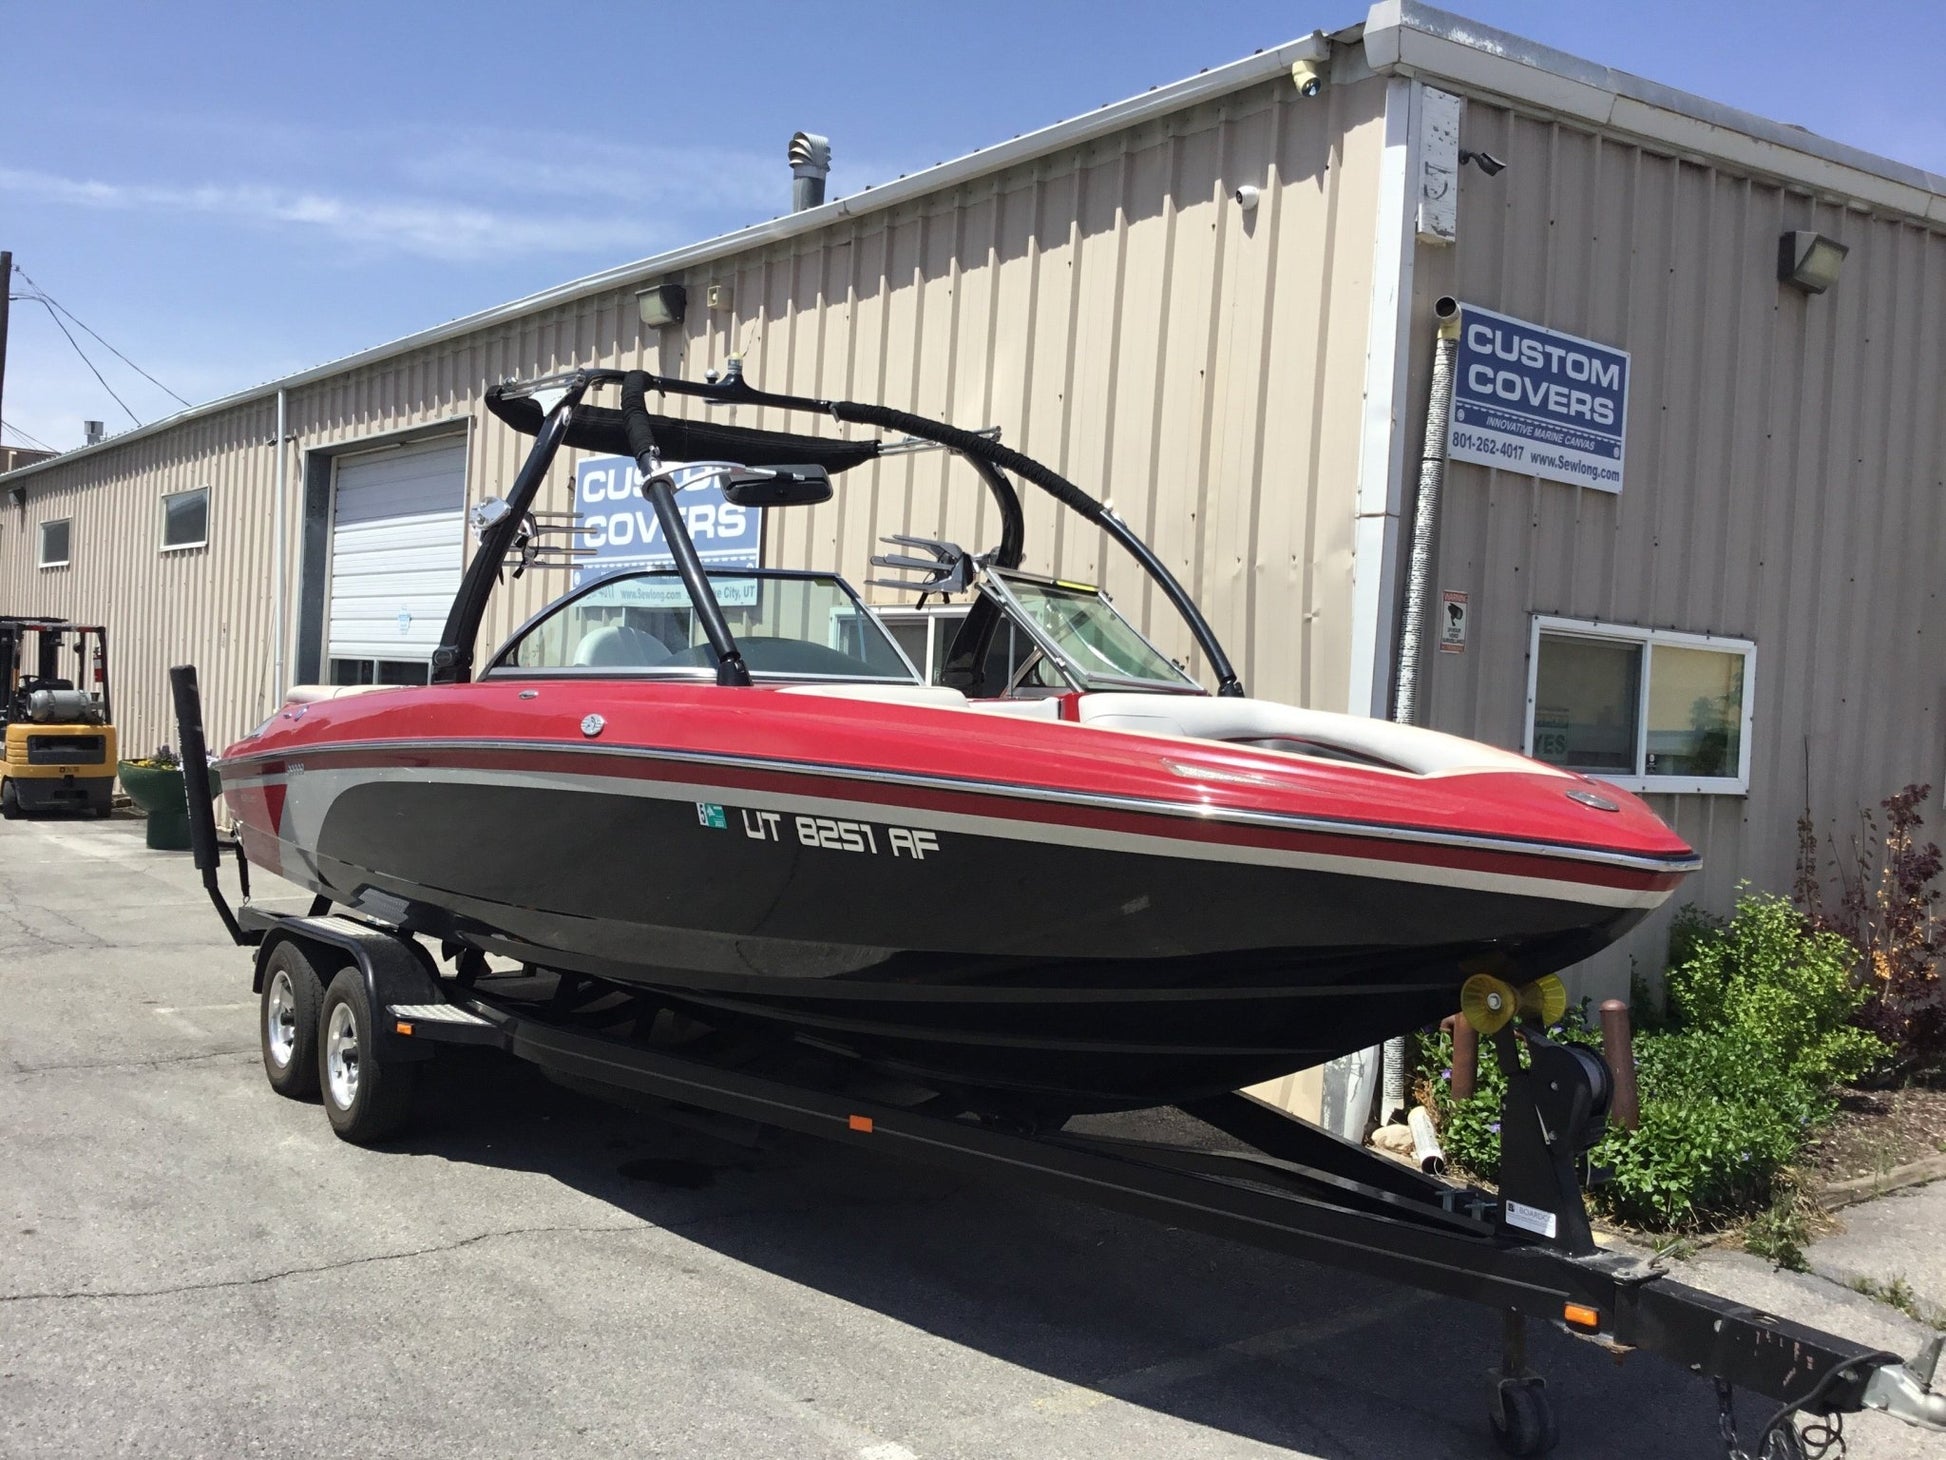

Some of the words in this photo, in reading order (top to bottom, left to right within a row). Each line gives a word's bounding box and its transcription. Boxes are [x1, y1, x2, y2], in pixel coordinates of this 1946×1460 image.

[1467, 324, 1620, 391] CUSTOM
[1468, 363, 1615, 426] COVERS
[1452, 431, 1525, 461] 801-262-4017
[1530, 451, 1620, 482] www.Sewlong.com
[1486, 415, 1533, 437] INNOVATIVE
[1534, 427, 1564, 443] MARINE
[1564, 435, 1596, 451] CANVAS
[583, 502, 747, 548] COVRS
[743, 585, 756, 598] UT
[741, 809, 781, 842] UT
[795, 816, 878, 854] 8251
[888, 827, 940, 860] AF
